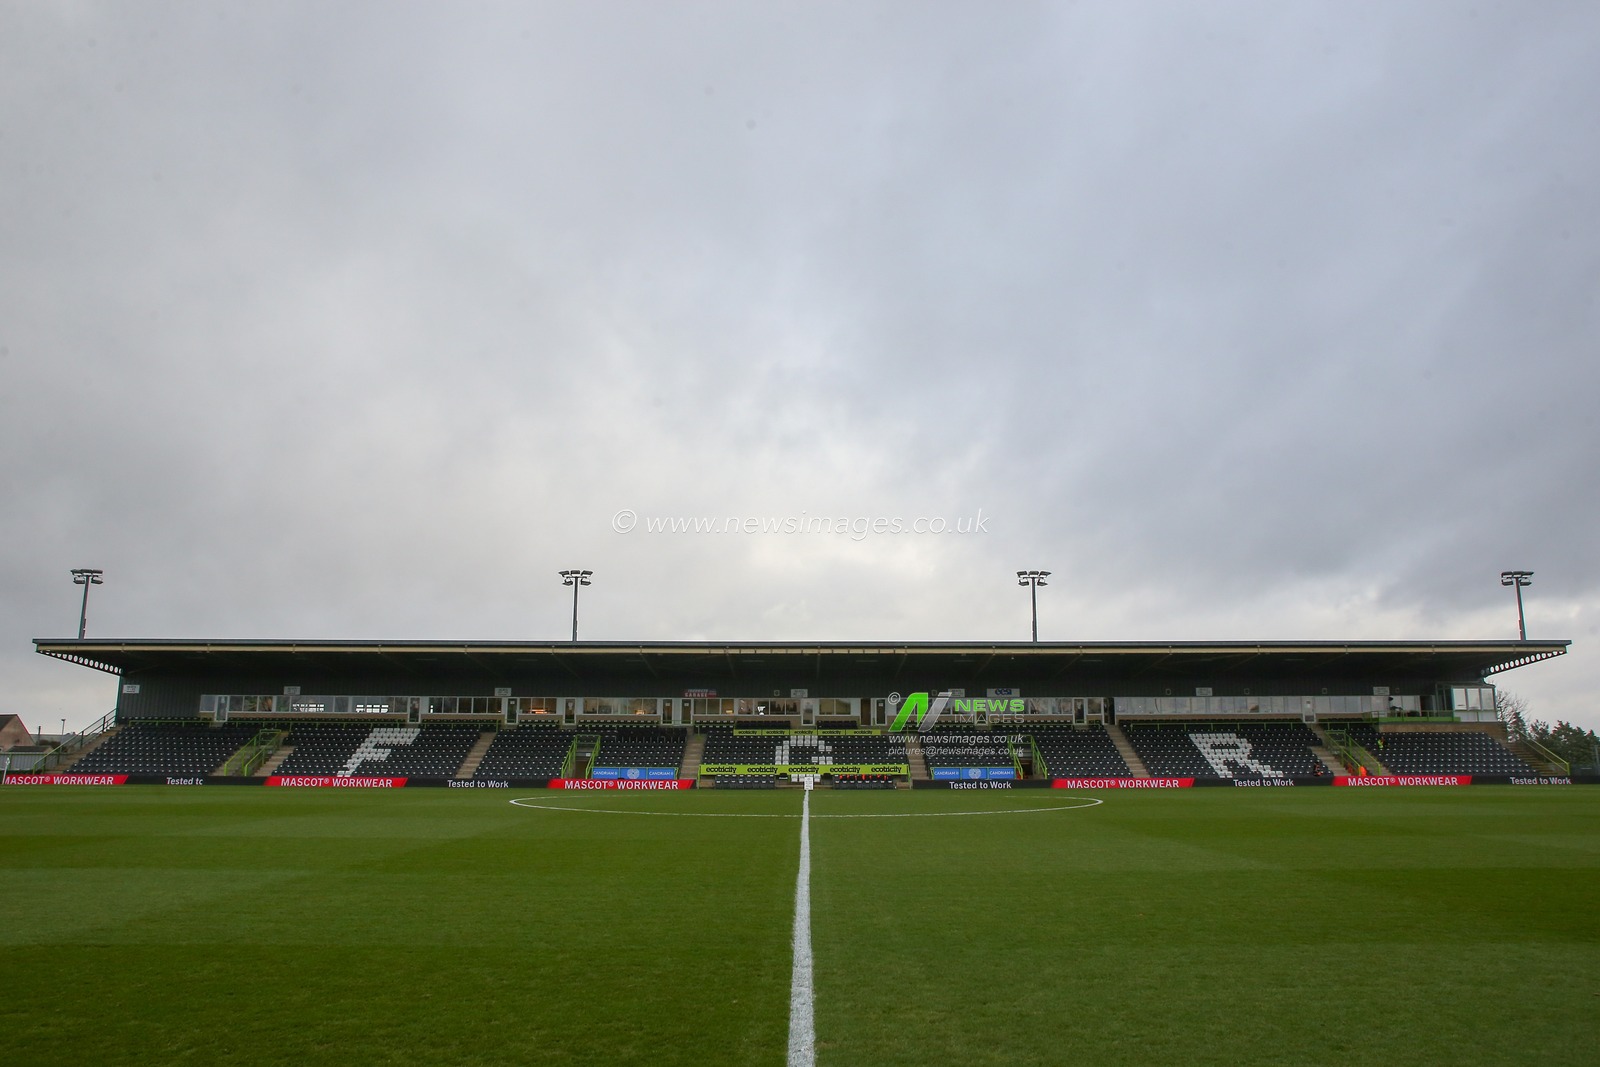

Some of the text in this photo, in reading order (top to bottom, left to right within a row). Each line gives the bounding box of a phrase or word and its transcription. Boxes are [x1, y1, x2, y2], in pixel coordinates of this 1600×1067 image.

[53, 776, 114, 785] WORKWEAR
[332, 778, 392, 787] WORKWEAR
[617, 781, 678, 789] WORKWEAR
[1398, 777, 1458, 786] WORKWEAR
